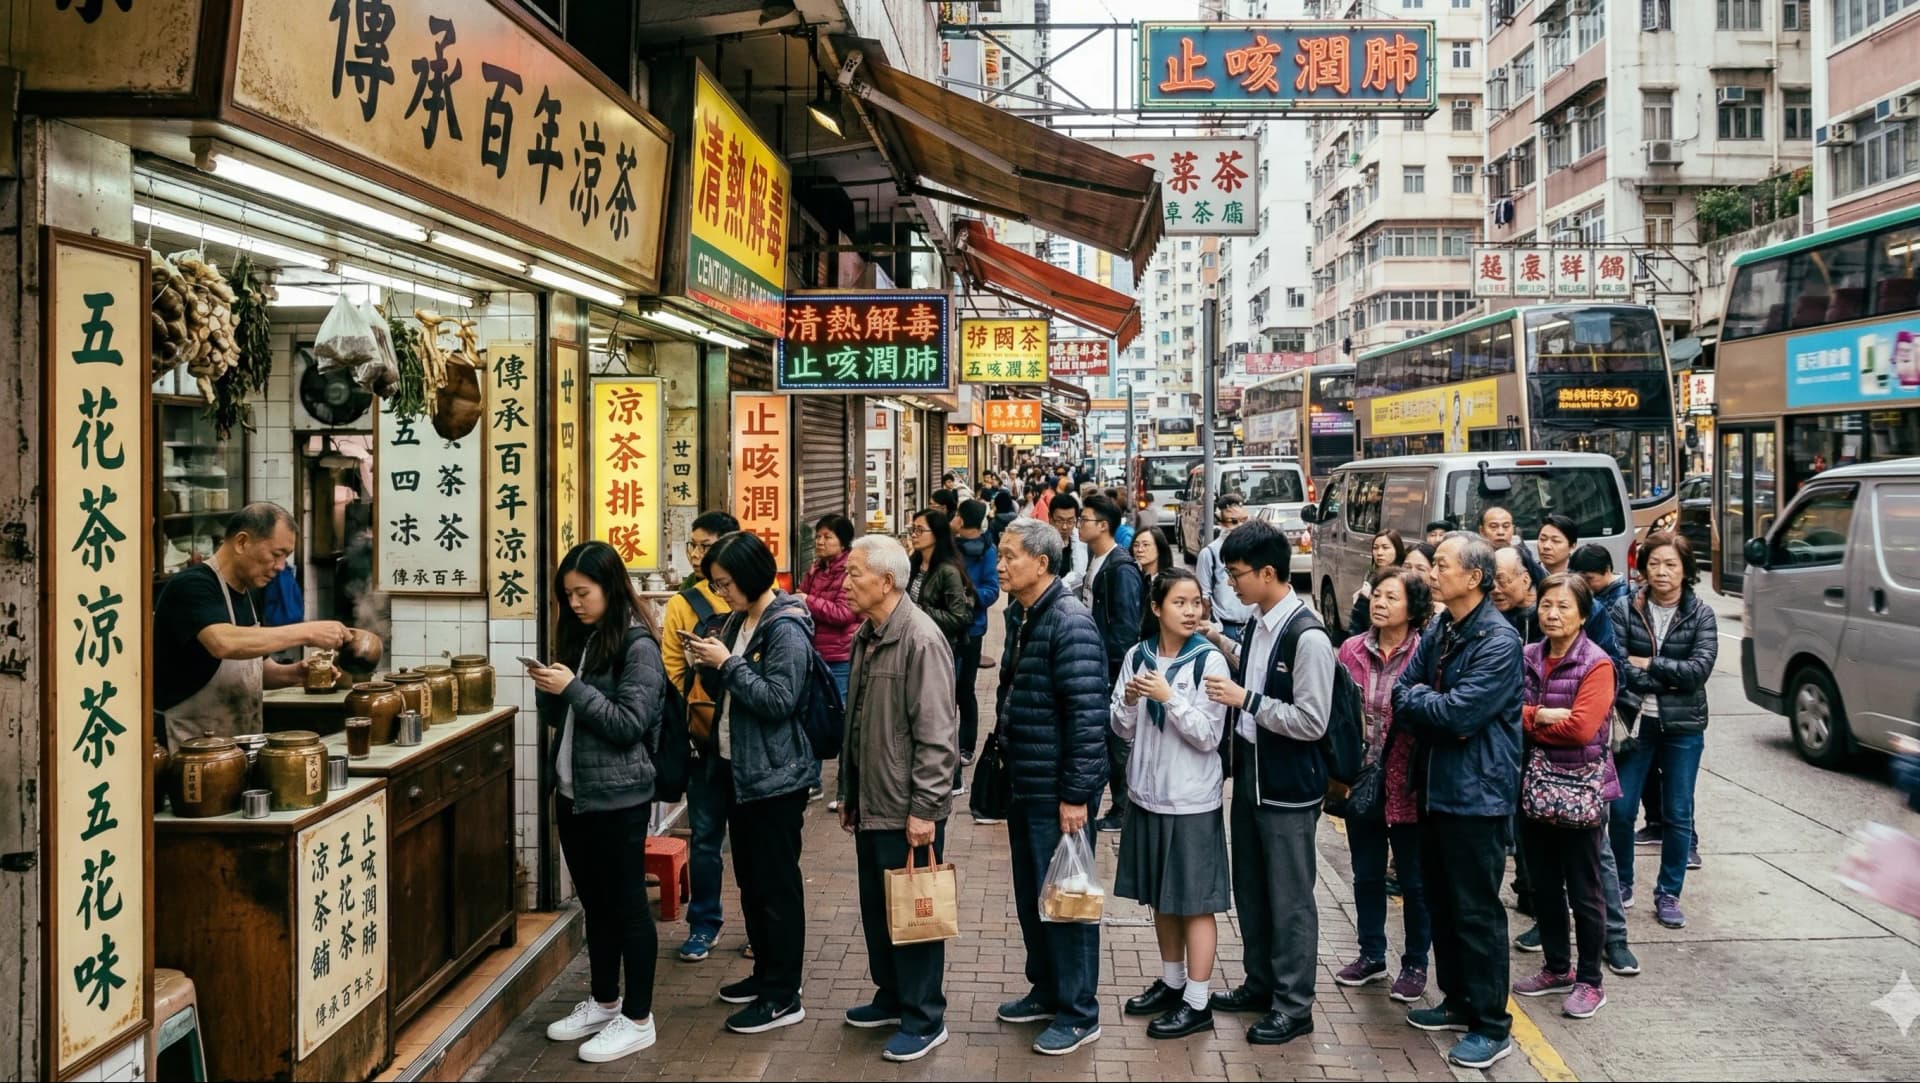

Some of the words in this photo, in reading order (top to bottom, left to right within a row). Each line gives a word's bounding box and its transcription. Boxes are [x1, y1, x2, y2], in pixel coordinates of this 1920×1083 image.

[328, 0, 639, 242] 傳承百年涼茶
[1158, 34, 1418, 95] 止咳潤肺
[698, 106, 784, 268] 清熱解毒
[787, 302, 940, 342] 清熱解毒
[787, 344, 939, 381] 止咳潤肺
[492, 354, 529, 607] 傳承百年涼茶
[605, 387, 647, 562] 涼茶排隊
[672, 440, 692, 501] 廿四味
[392, 568, 468, 587] 傳承百年
[70, 291, 129, 1011] 五花茶涼茶五花味
[337, 832, 356, 962] 五花茶
[361, 813, 378, 956] 止咳潤肺
[315, 968, 374, 1028] 傳承百年茶
